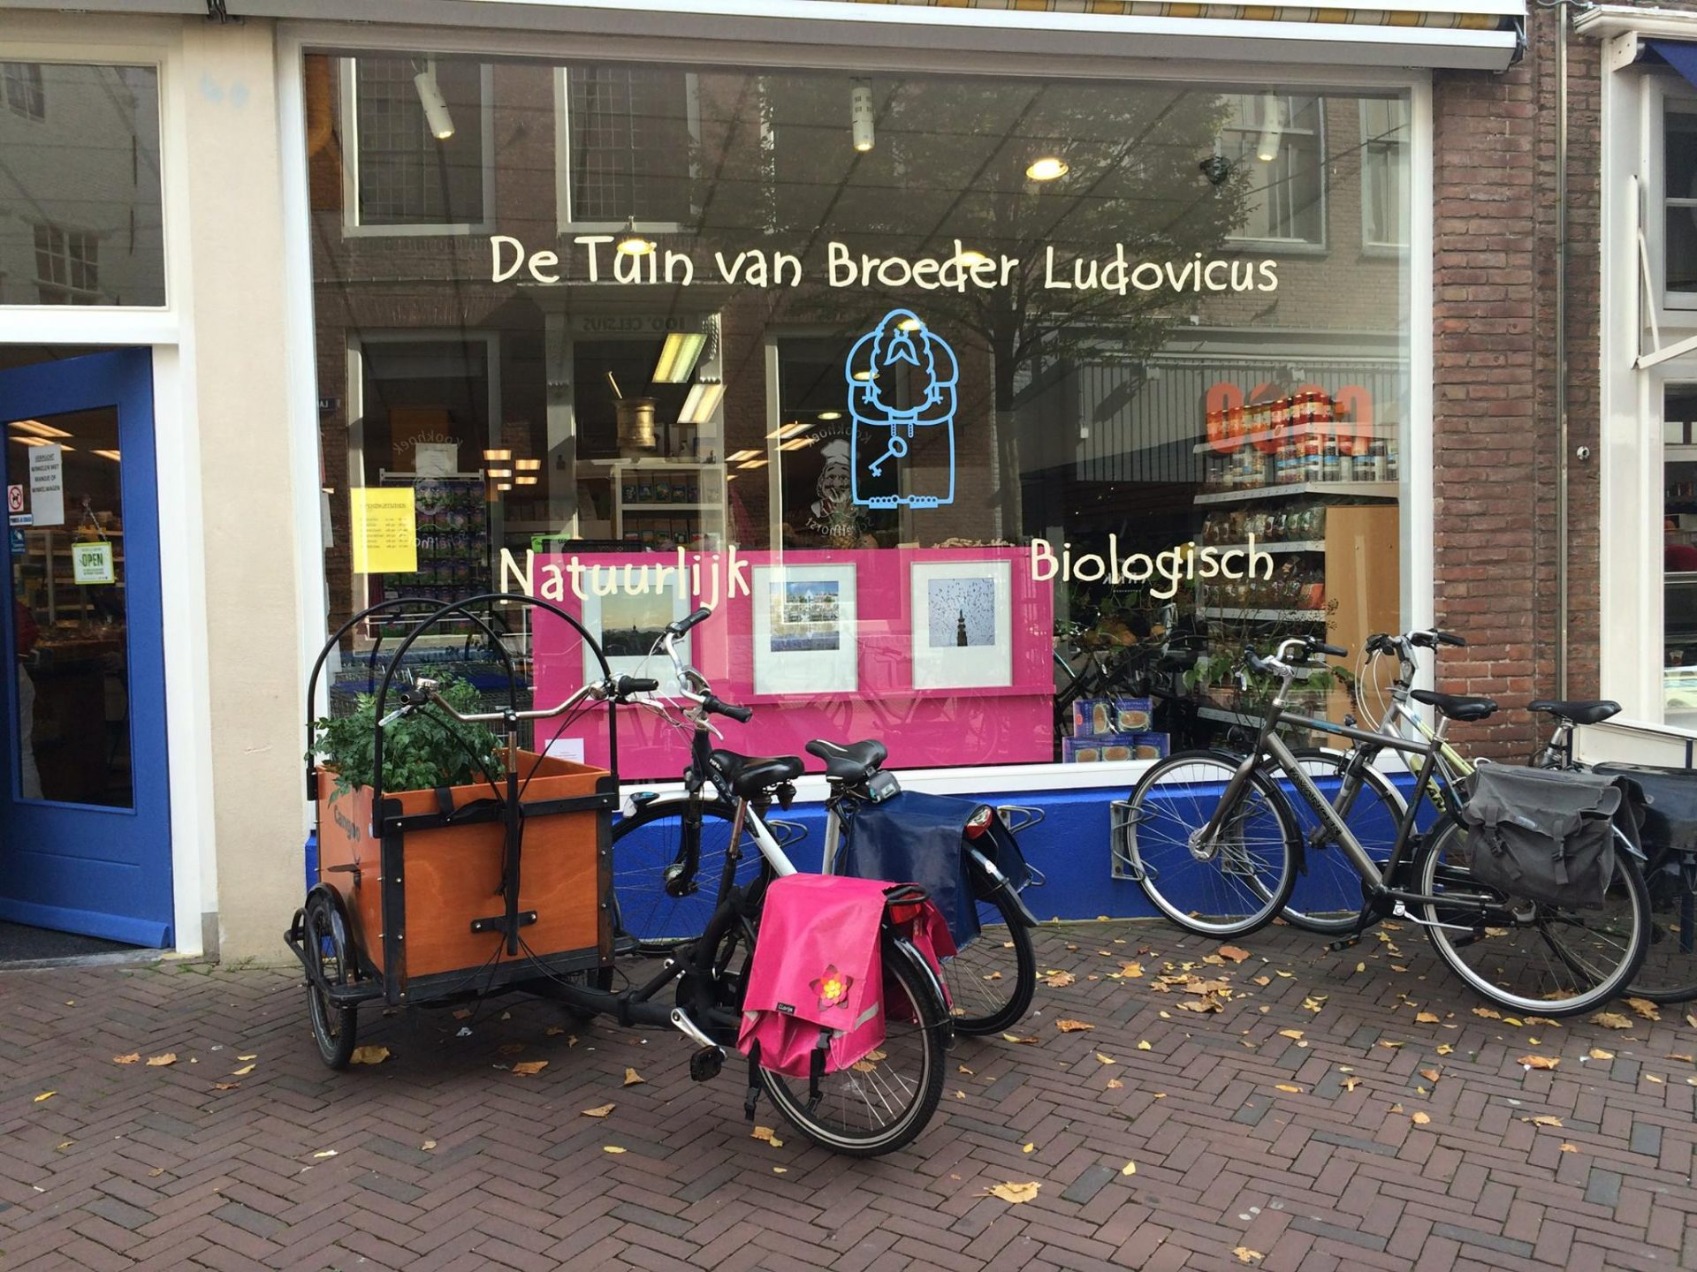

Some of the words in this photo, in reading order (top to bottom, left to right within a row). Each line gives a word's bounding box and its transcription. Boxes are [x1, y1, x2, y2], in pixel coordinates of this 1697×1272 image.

[490, 235, 560, 284] De
[575, 236, 694, 287] Tuin
[715, 249, 803, 289] van
[828, 239, 1019, 294] Broeder
[1044, 243, 1279, 297] Ludovicus
[82, 553, 103, 567] OPEN
[500, 544, 750, 611] Natuurlijk
[1031, 532, 1275, 599] Biologisch
